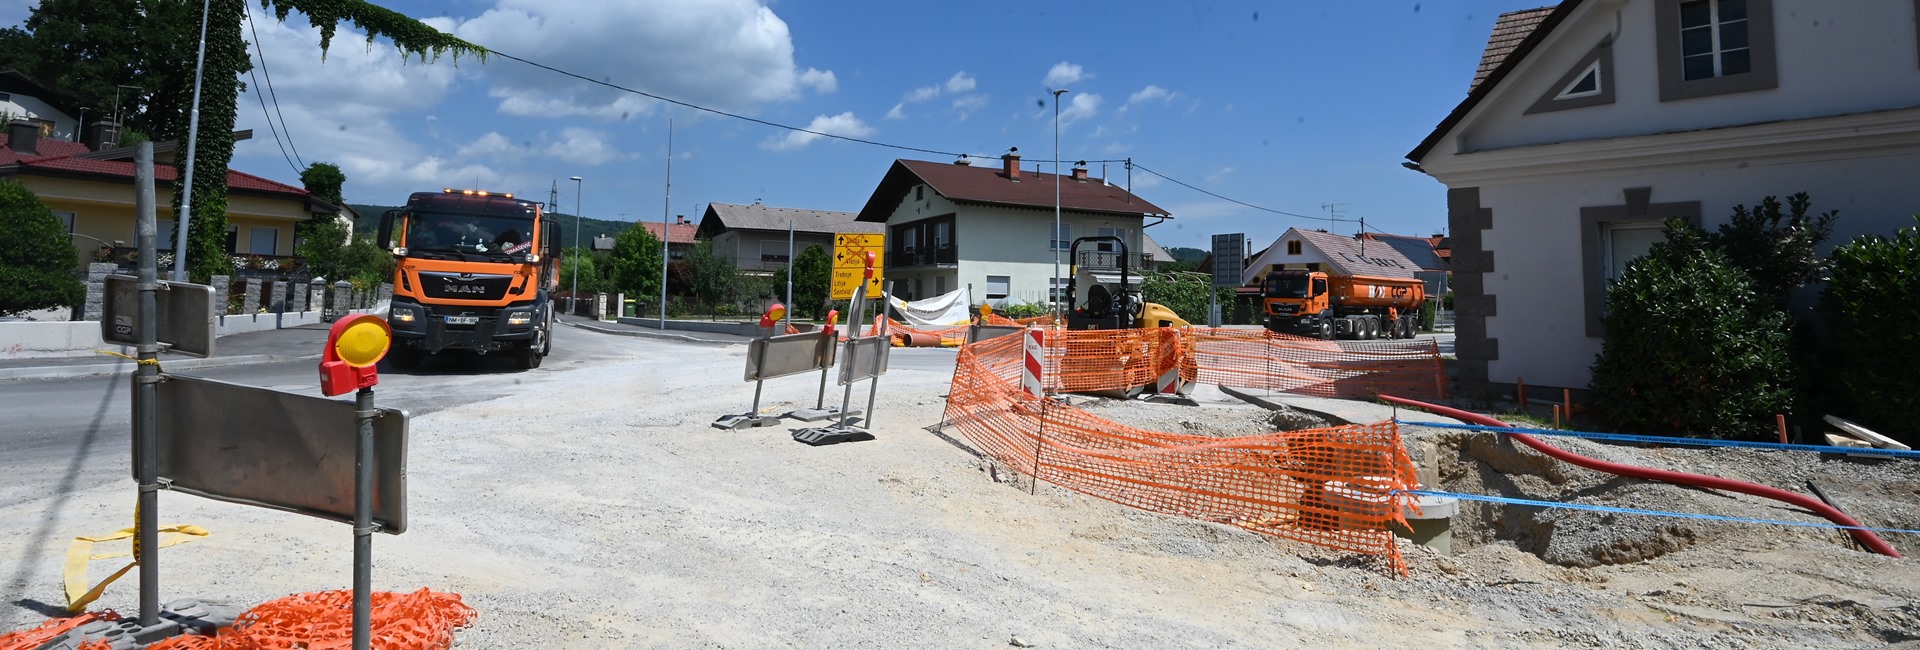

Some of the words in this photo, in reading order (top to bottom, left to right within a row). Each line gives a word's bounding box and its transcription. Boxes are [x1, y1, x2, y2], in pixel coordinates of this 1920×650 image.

[444, 284, 485, 294] MAN
[1391, 286, 1408, 298] CGP
[116, 326, 131, 334] CGP
